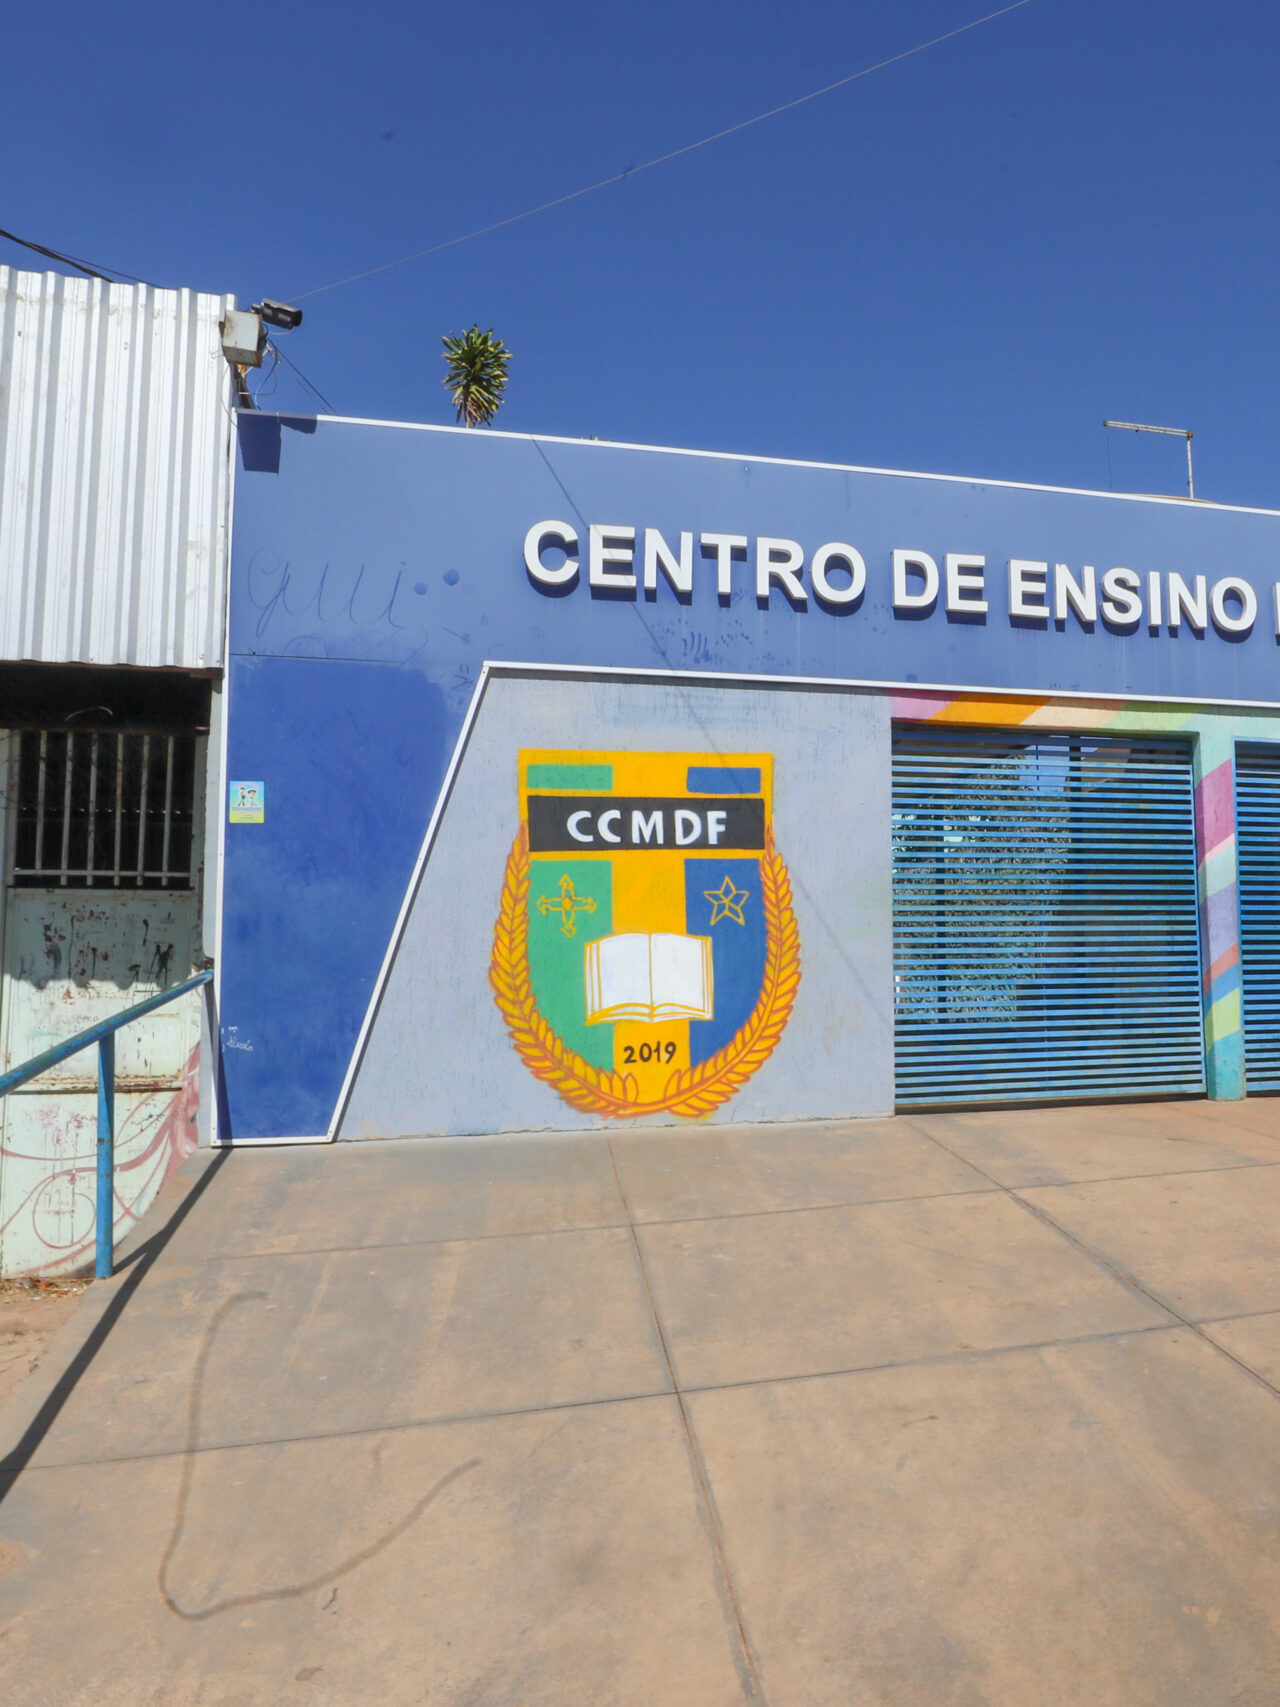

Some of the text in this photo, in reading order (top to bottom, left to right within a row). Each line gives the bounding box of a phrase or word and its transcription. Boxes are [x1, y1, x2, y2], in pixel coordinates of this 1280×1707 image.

[523, 519, 867, 603] CENTRO
[892, 548, 989, 614] DE
[1008, 558, 1258, 633] ENSINO
[566, 809, 728, 846] CCMDF
[623, 1041, 678, 1065] 2019
